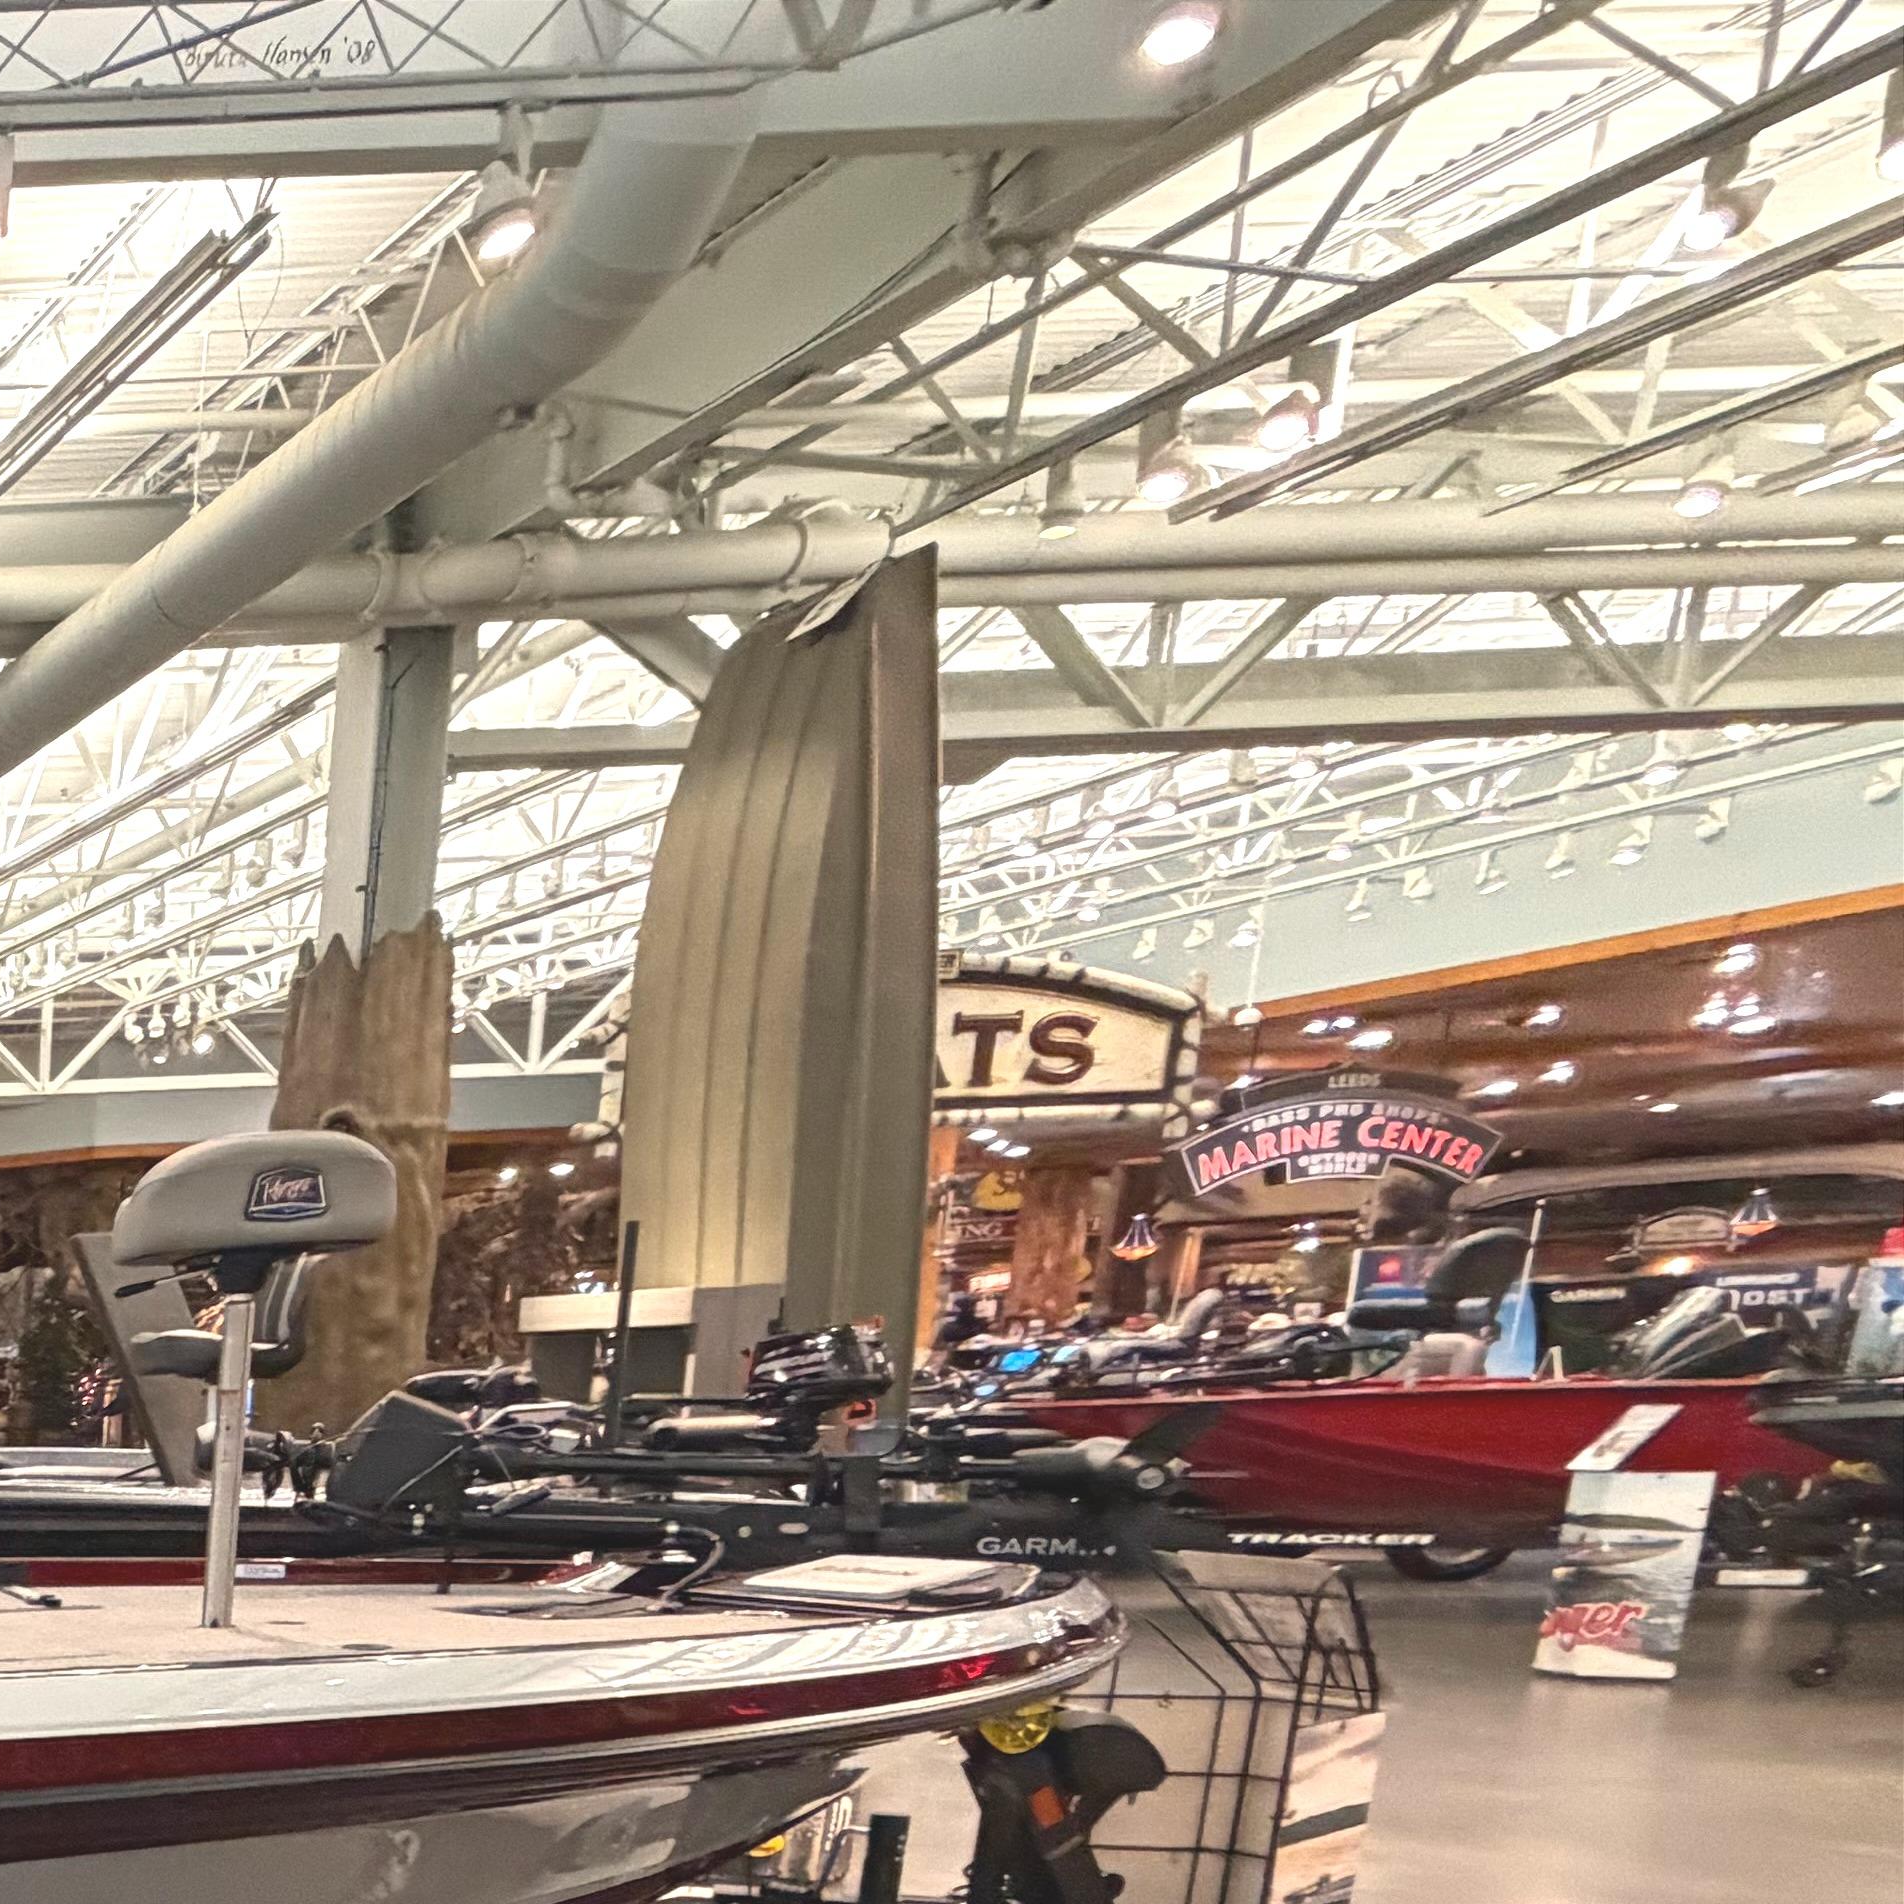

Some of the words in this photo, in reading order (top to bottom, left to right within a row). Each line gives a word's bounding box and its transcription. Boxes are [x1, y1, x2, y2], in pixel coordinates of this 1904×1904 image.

[936, 1010, 1101, 1088] TS
[1327, 1073, 1381, 1088] LEEDS
[1197, 1119, 1342, 1187] MARINE
[1356, 1115, 1484, 1174] CENTER
[976, 1536, 1117, 1557] GARM
[1227, 1532, 1437, 1546] TRACKER
